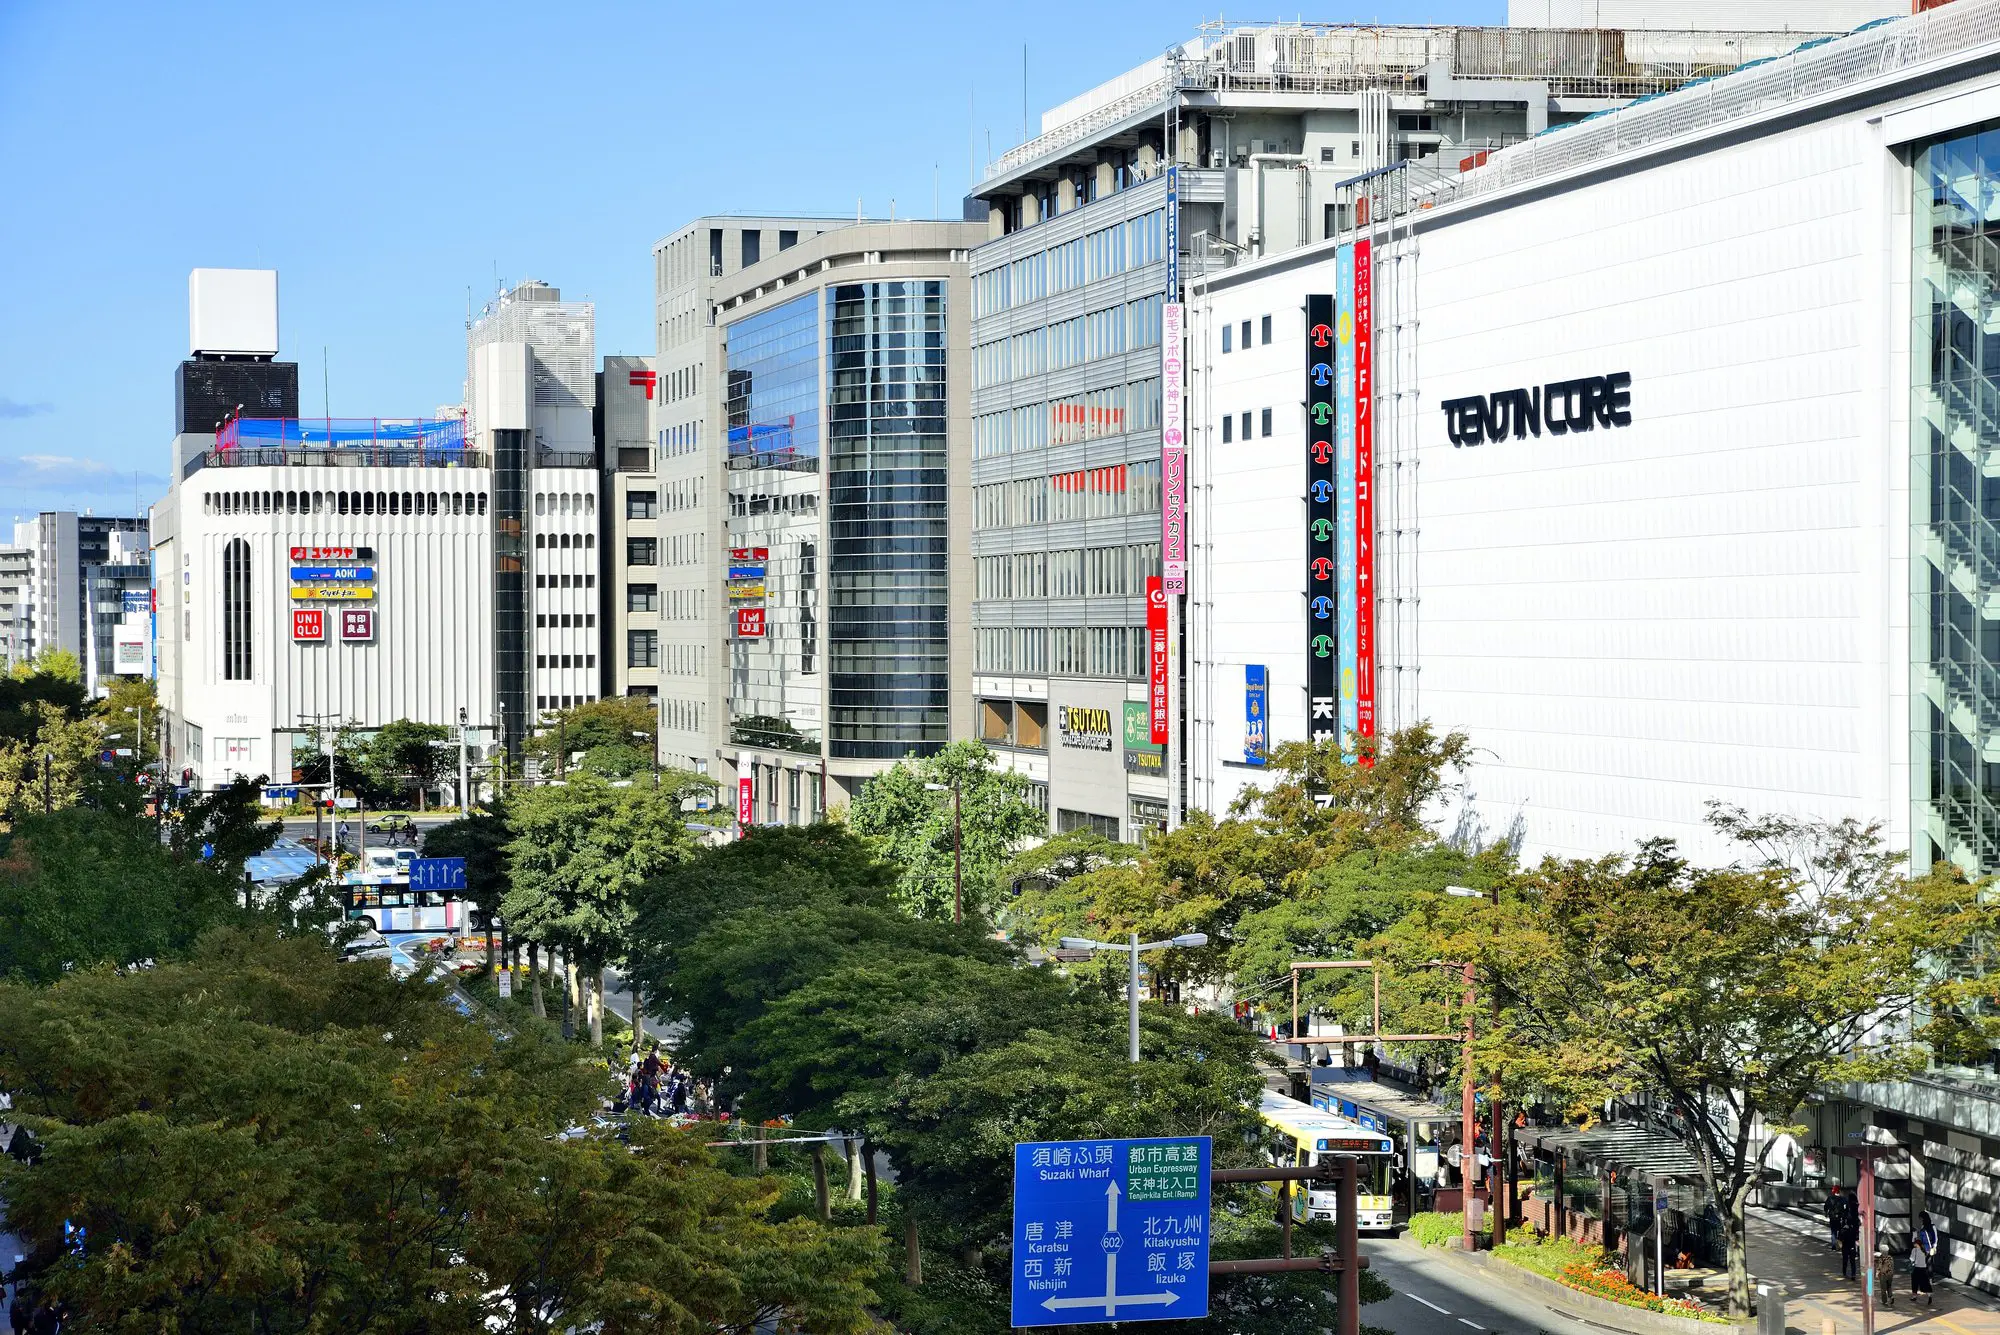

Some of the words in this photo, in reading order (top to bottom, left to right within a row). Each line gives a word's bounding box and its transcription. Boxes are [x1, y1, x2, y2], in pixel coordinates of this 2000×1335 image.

[1166, 305, 1179, 357] 脱毛ラボ
[1166, 376, 1179, 427] 天神コア
[1441, 386, 1541, 449] TENJIN
[1544, 371, 1632, 436] CORE
[335, 569, 356, 578] AOKI
[1166, 580, 1182, 589] B2
[297, 614, 317, 624] UNI
[346, 614, 366, 623] 無印
[297, 626, 320, 636] QLO
[346, 625, 366, 634] 良品
[1154, 629, 1166, 732] 三菱UFJ信託銀行
[1067, 706, 1109, 733] TSUTAYA
[1138, 753, 1161, 768] TSUTAYA
[1032, 1145, 1113, 1167] 須崎ふ頭
[1130, 1145, 1198, 1163] 都市高速
[1040, 1168, 1075, 1181] Suzaki
[1079, 1168, 1110, 1179] Wharf
[1129, 1165, 1151, 1174] Urban
[1153, 1164, 1197, 1174] Expressway
[1129, 1176, 1197, 1191] 天神北入口
[1129, 1192, 1161, 1200] Tenjin-kita
[1025, 1220, 1073, 1241] 唐津
[1143, 1214, 1202, 1235] 北九州
[1028, 1243, 1069, 1253] Karatsu
[1103, 1237, 1120, 1248] 602
[1144, 1236, 1200, 1248] Kitakyushu
[1024, 1257, 1072, 1278] 西新
[1147, 1252, 1195, 1272] 飯塚
[1028, 1279, 1067, 1291] Nishijin
[1156, 1273, 1186, 1284] Iizuka
